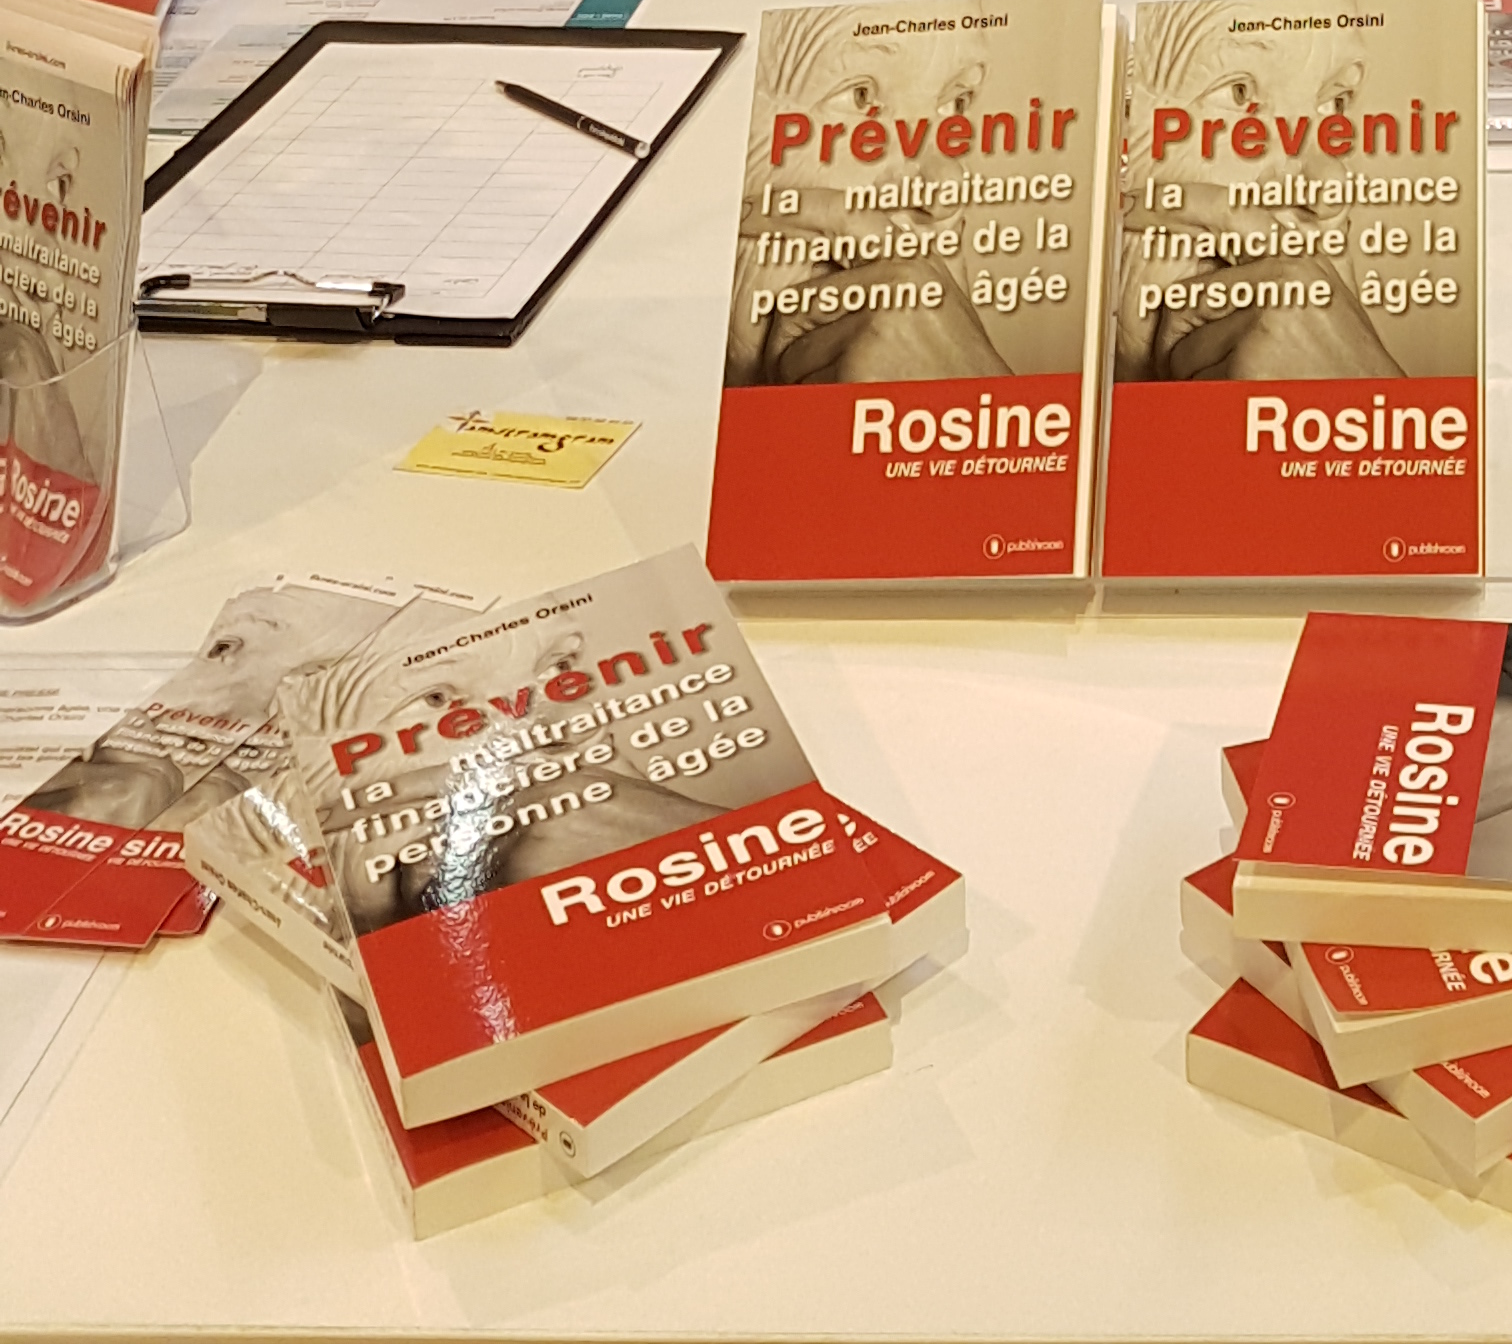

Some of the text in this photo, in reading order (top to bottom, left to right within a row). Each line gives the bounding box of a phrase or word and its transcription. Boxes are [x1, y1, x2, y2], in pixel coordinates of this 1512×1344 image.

[852, 13, 1010, 38] Jean-Charles Orsini
[1228, 13, 1385, 34] Jean-Charles Orsini
[770, 98, 1077, 167] Prévenir
[1150, 99, 1462, 160] Prévenir
[2, 179, 107, 251] évenir
[762, 169, 1074, 216] la maltraitance
[1144, 171, 1459, 211] la maltraitance
[756, 217, 1069, 266] financière de la
[1141, 219, 1458, 261] financière de la
[750, 268, 1068, 323] personne âgée
[1138, 270, 1459, 318] personne âgée
[851, 393, 1072, 455] Rosine
[1245, 395, 1468, 453] Rosine
[885, 453, 1068, 478] UNE VIE DÉTOURNÉE
[1281, 455, 1466, 478] UNE VIE DÉTOURNÉE
[402, 593, 595, 668] Jean-Charles Orsini
[330, 621, 714, 778] Prévenir
[629, 716, 692, 751] de
[702, 689, 752, 724] la
[340, 661, 735, 812] la maltraitance
[1380, 724, 1400, 754] UNE
[1376, 755, 1394, 777] VIE
[1382, 702, 1476, 867] Rosine
[0, 812, 114, 853] Rosine
[364, 723, 768, 886] peronne âgée
[540, 807, 827, 928] Rosine
[606, 902, 653, 929] UNE
[661, 887, 697, 911] VIE
[704, 838, 837, 897] DÉTOURNÉE
